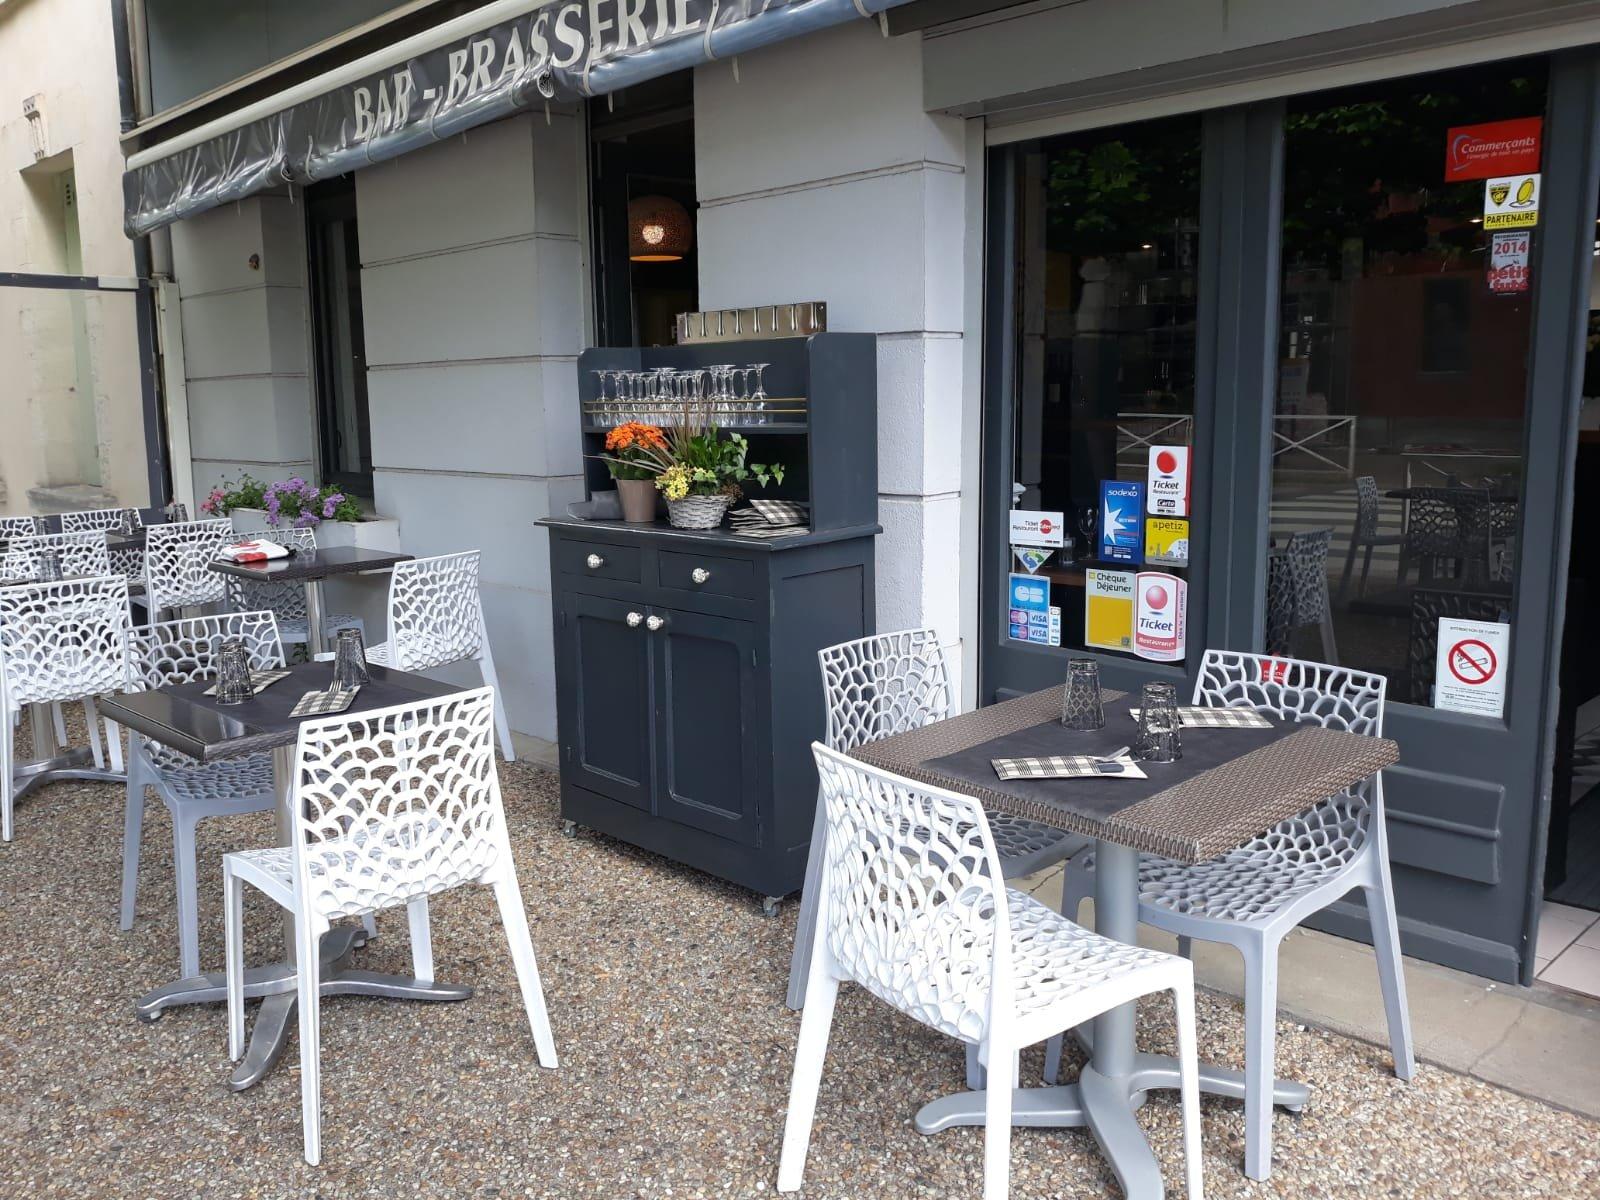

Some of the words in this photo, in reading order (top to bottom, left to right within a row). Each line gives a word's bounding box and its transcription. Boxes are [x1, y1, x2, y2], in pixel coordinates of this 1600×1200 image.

[354, 68, 416, 140] BAR
[1461, 137, 1536, 154] Commerçants
[1486, 212, 1536, 224] PARTENAIRE
[1494, 240, 1528, 255] 2014
[1153, 480, 1180, 490] Ticket
[1107, 489, 1138, 497] sodexo
[1152, 521, 1184, 531] apetiz
[1096, 572, 1127, 583] Chèque
[1096, 581, 1132, 593] Déjeuner
[1031, 614, 1047, 623] VISA
[1140, 617, 1174, 631] Ticket
[1031, 630, 1047, 638] VISA
